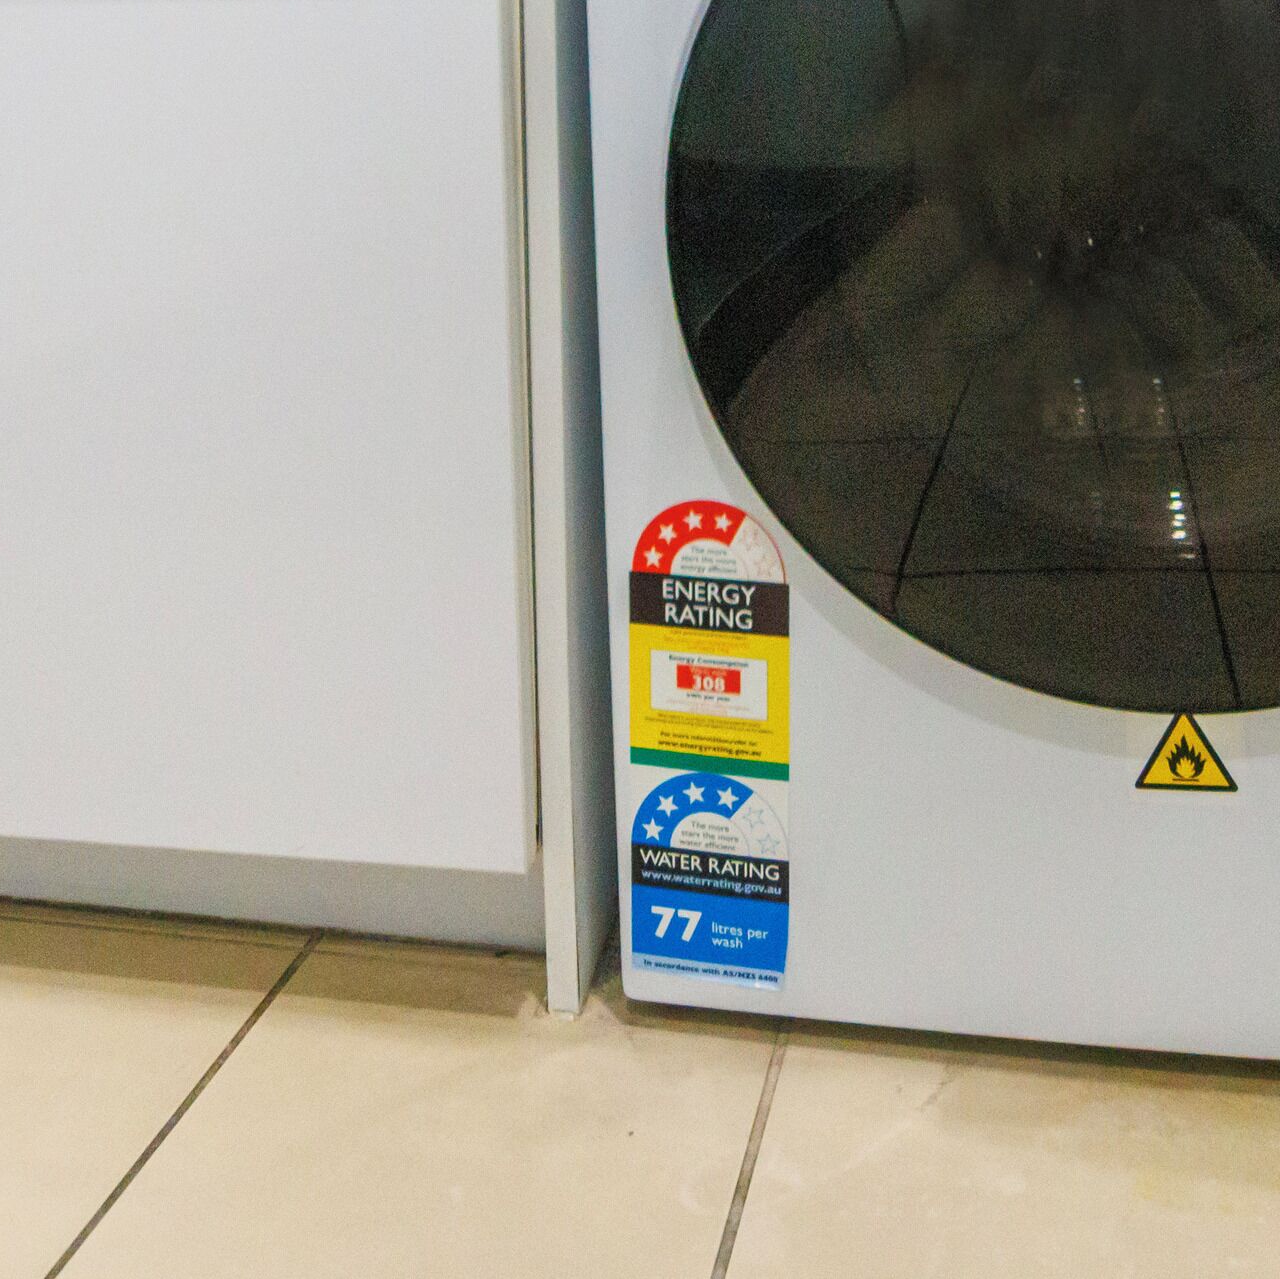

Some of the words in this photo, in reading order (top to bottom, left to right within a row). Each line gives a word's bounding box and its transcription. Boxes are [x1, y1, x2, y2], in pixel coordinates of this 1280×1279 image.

[662, 578, 756, 606] ENERGY
[664, 604, 753, 630] RATING
[681, 830, 701, 839] stars
[718, 835, 739, 843] more
[691, 820, 705, 829] The
[708, 825, 730, 833] more
[679, 839, 702, 848] water
[640, 848, 702, 872] WATER
[709, 857, 780, 881] RATING
[641, 869, 782, 896] www.waterrating.gov.au
[650, 905, 702, 943] 77
[712, 921, 743, 937] litres
[747, 928, 768, 940] per
[712, 936, 743, 949] wash
